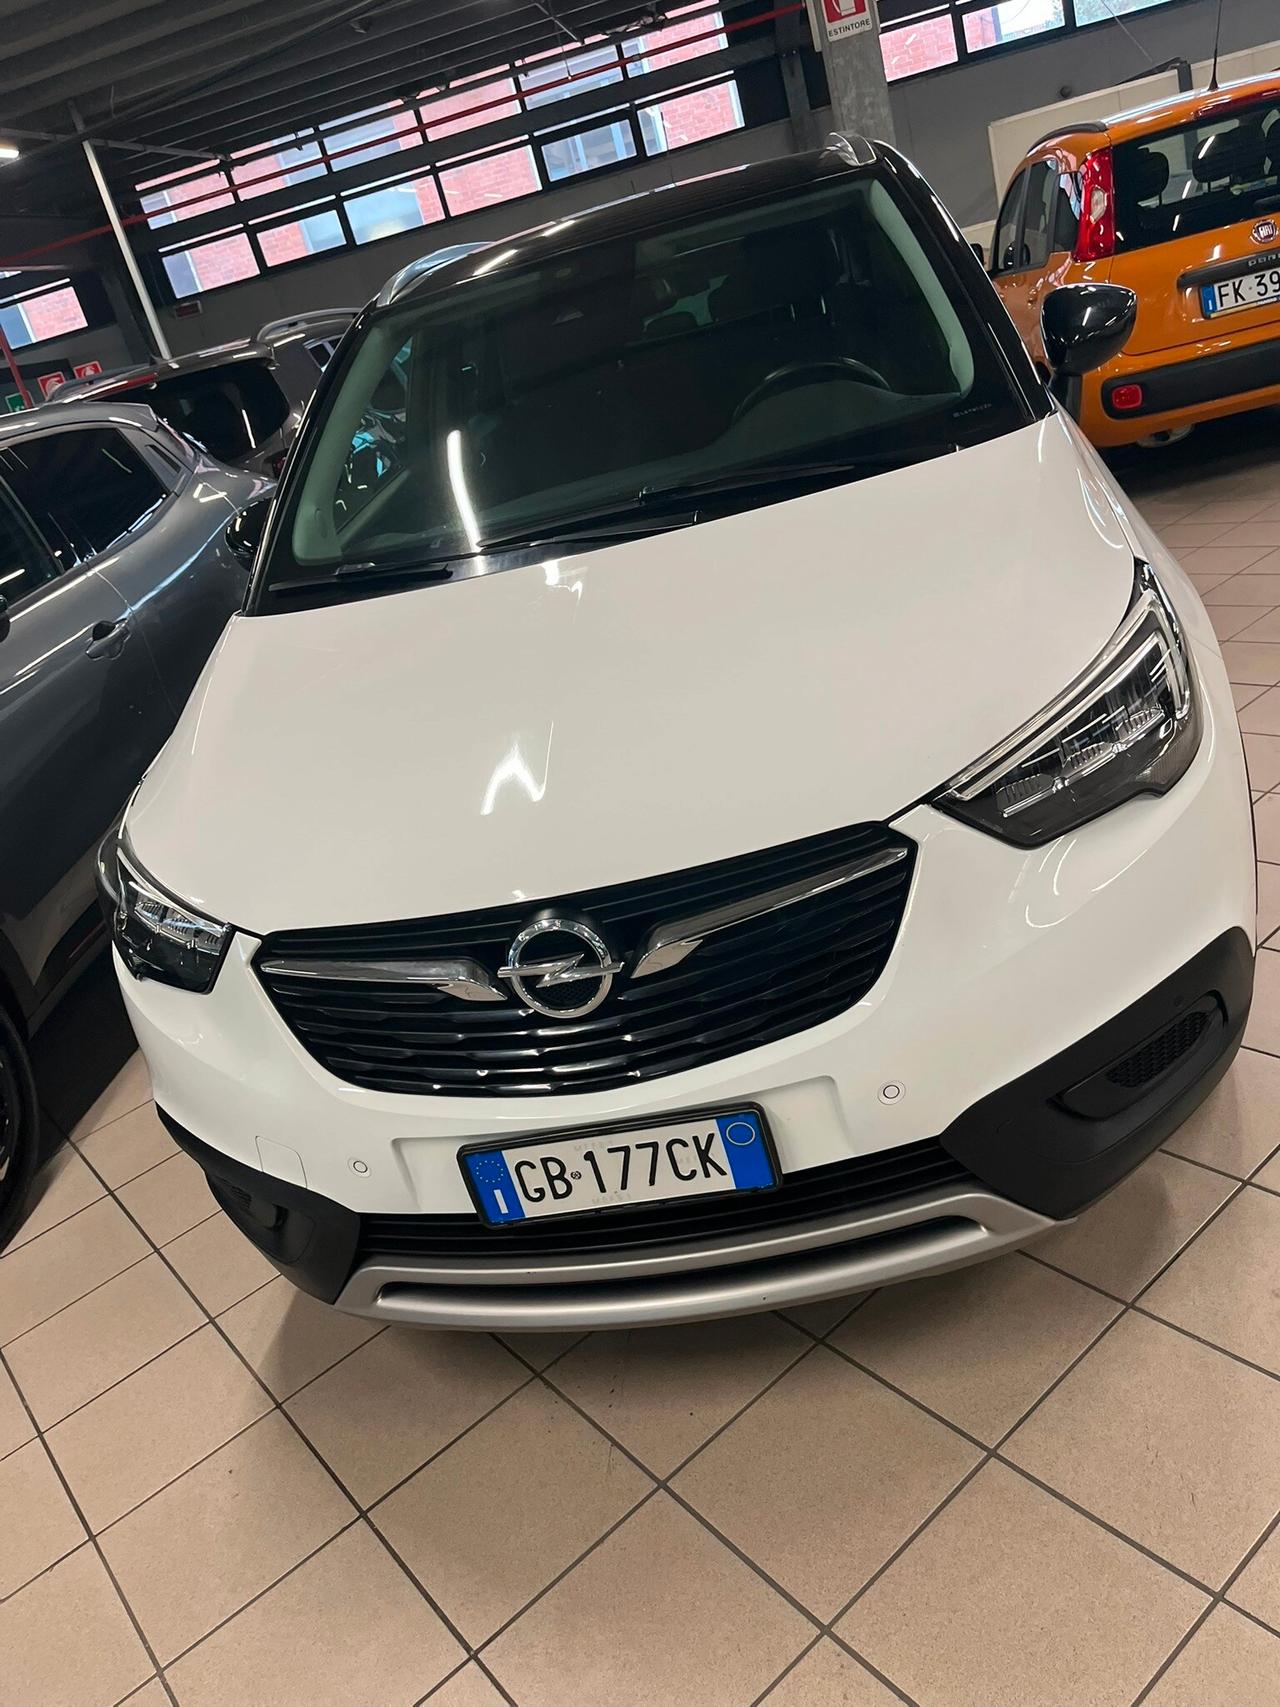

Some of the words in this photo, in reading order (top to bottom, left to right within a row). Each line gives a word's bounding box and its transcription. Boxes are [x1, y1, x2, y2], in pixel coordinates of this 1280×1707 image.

[828, 19, 871, 37] ESTINTORE
[1218, 280, 1246, 307] FK
[1254, 271, 1280, 297] 39
[493, 1189, 509, 1214] I
[514, 1157, 573, 1203] GB
[583, 1132, 728, 1194] 177CK
